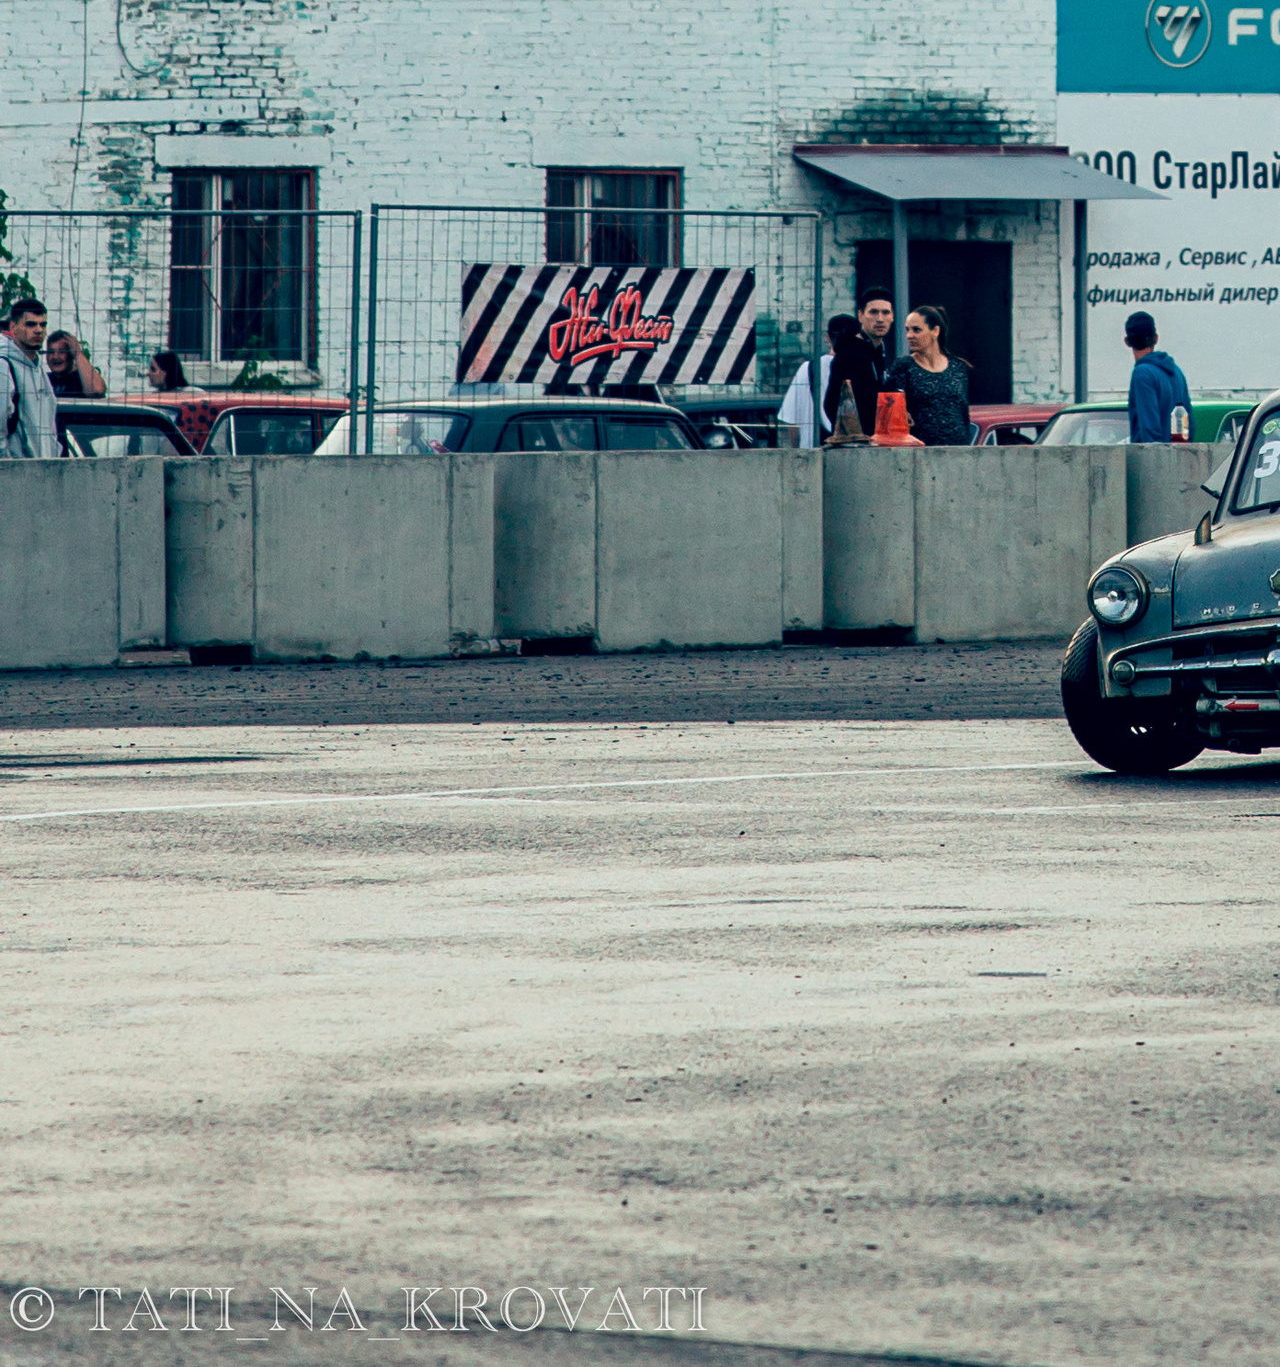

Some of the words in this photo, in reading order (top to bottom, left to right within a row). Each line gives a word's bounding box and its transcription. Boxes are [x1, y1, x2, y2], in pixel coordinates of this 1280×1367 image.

[1073, 250, 1161, 271] родажа
[1074, 282, 1215, 307] фициальный
[1219, 286, 1279, 305] дилер
